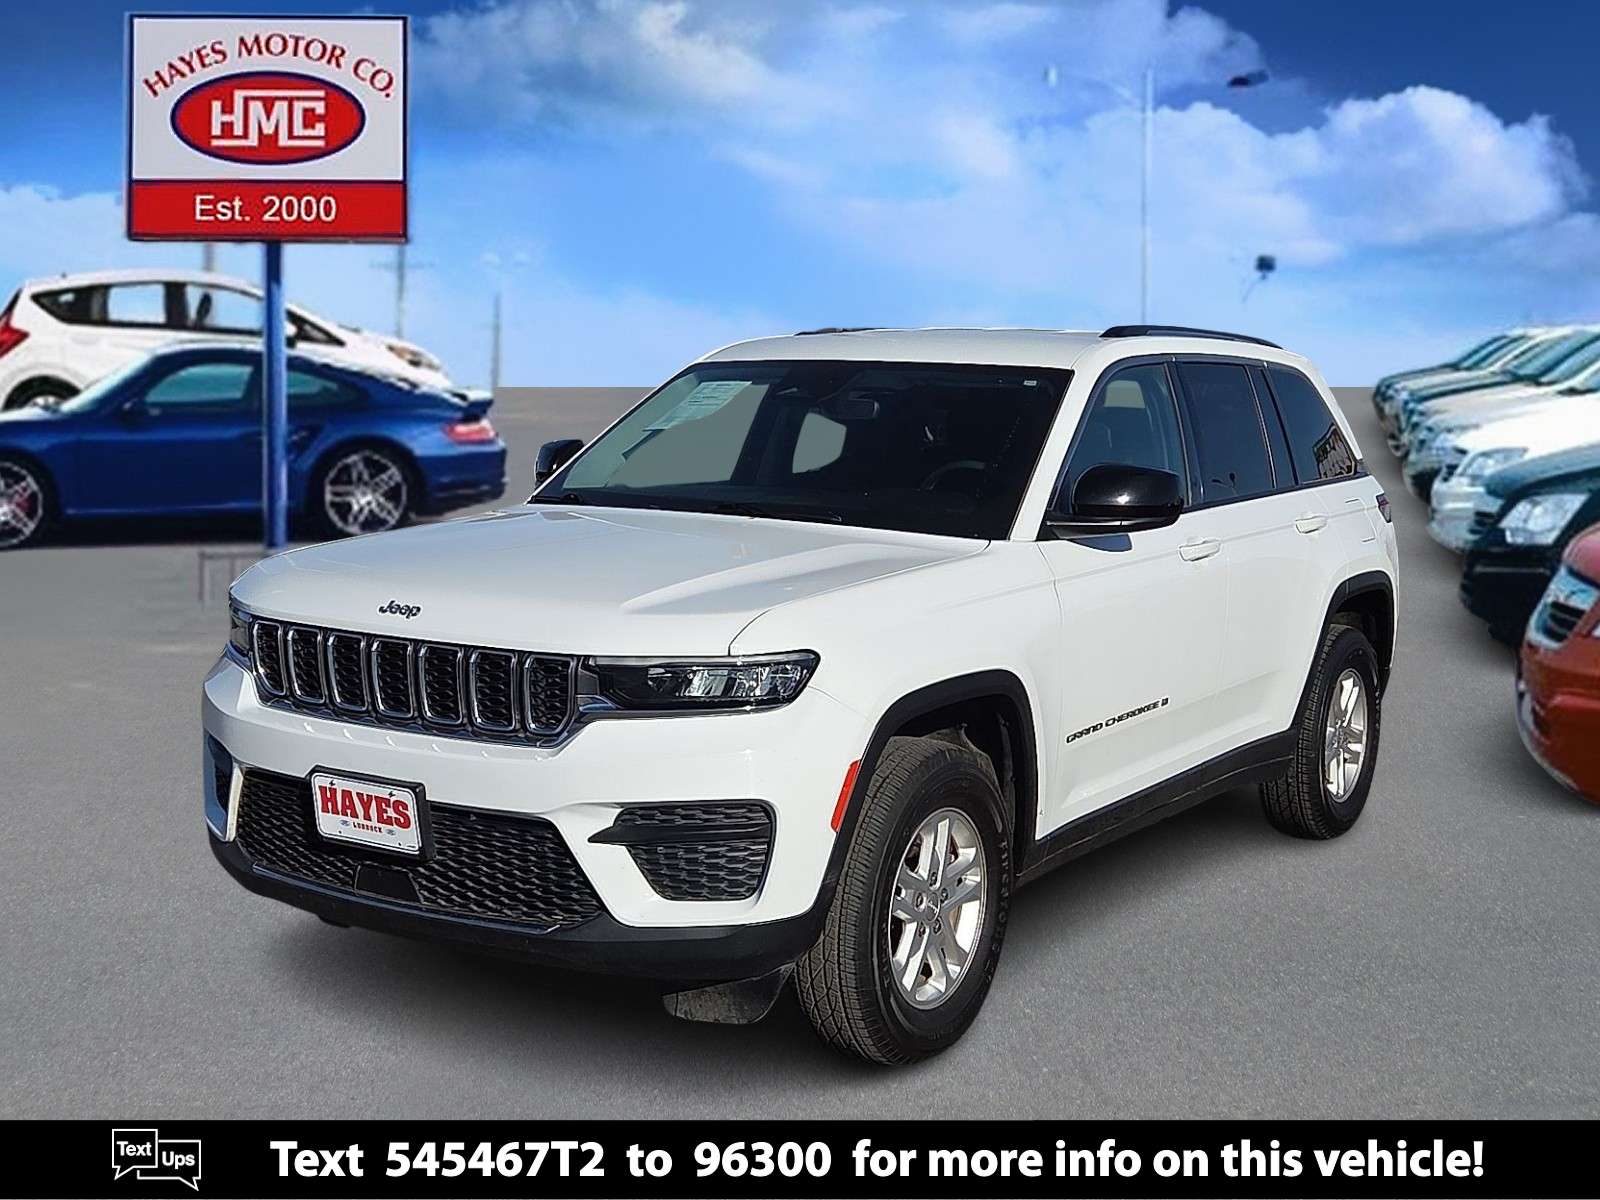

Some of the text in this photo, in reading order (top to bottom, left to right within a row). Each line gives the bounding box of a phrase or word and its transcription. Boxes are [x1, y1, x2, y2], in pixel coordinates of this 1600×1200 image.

[143, 32, 395, 99] HAYES MOTOR CO.
[210, 88, 326, 147] HMC
[194, 194, 337, 222] Est. 2000
[378, 599, 421, 620] Jeep
[1066, 700, 1161, 744] GRAND CHEROKEE
[318, 785, 412, 830] HAYES
